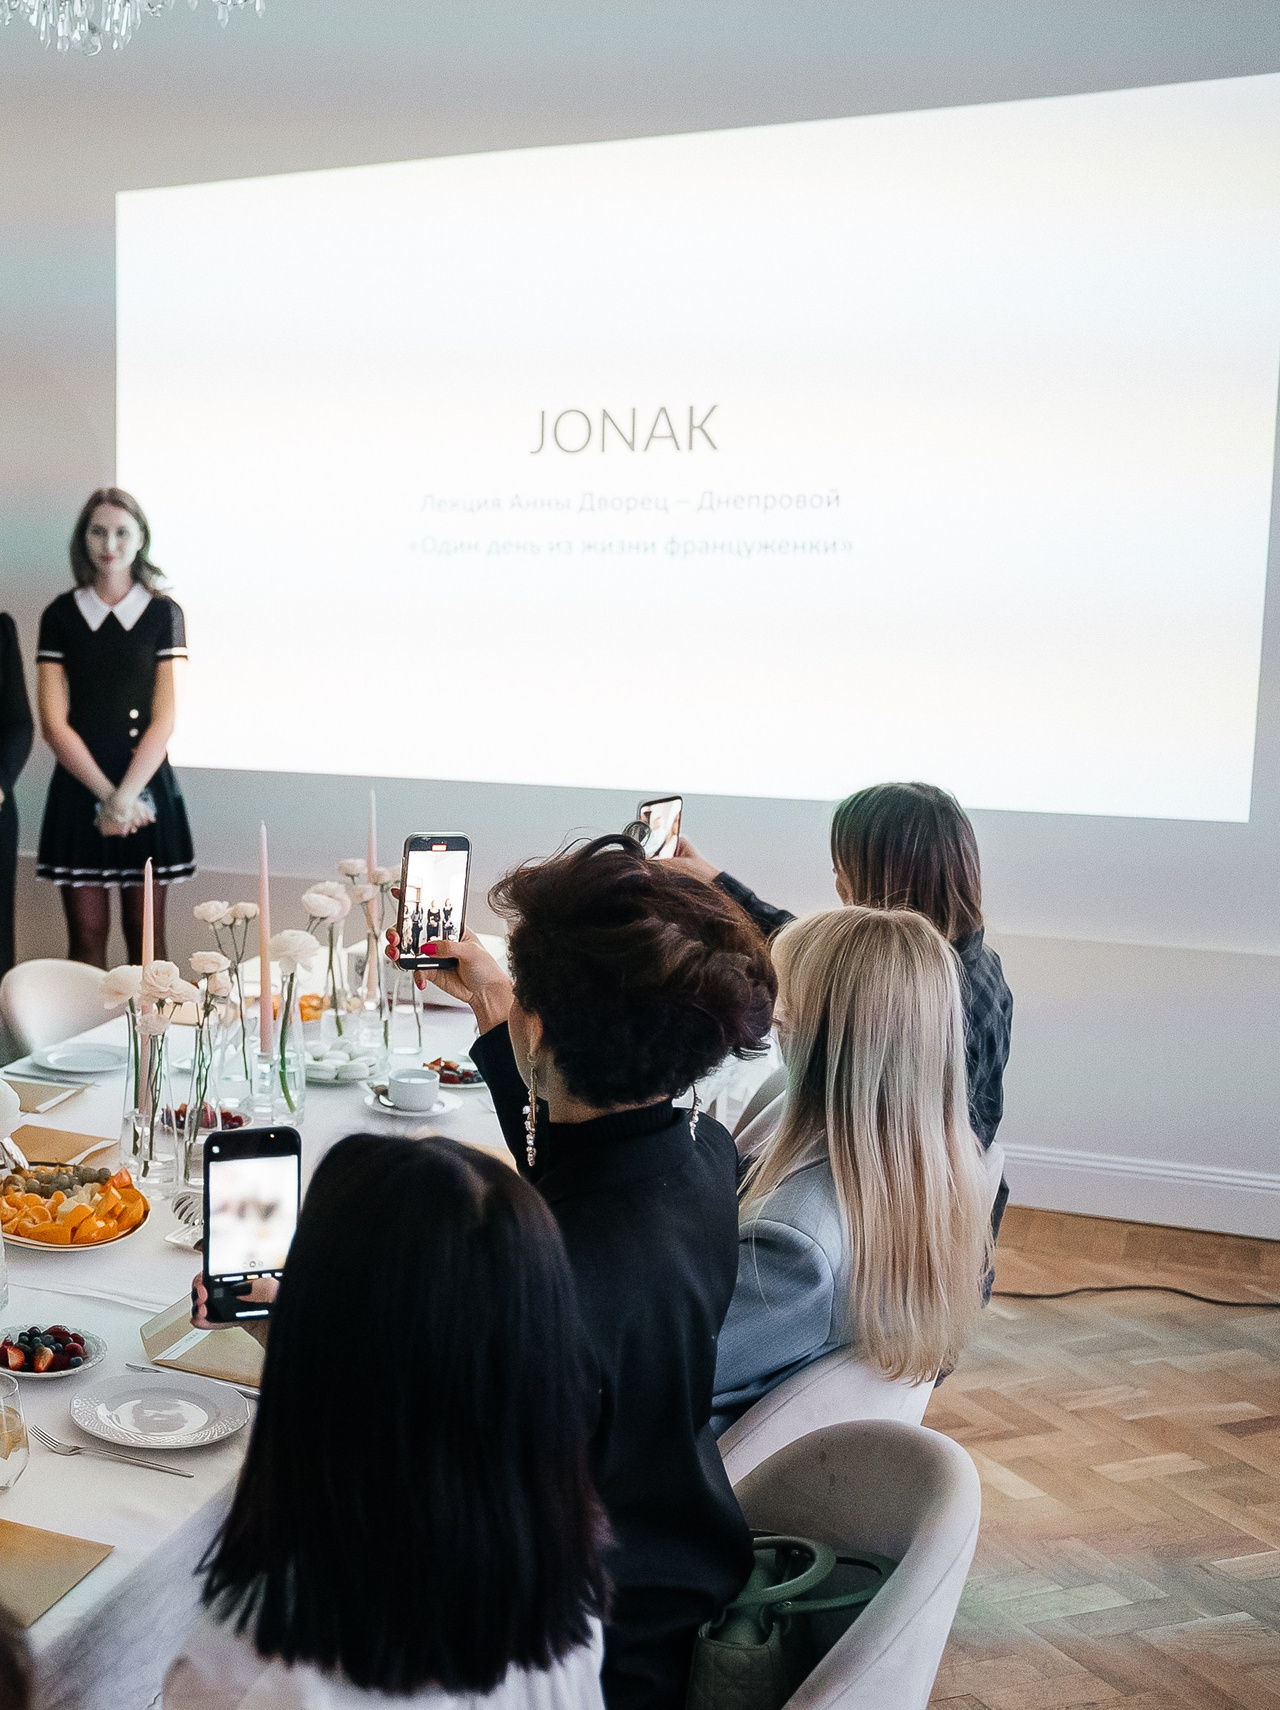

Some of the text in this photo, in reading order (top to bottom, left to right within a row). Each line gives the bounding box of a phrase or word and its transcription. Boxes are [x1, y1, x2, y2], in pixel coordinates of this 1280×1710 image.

[529, 403, 719, 456] JONAK
[419, 493, 503, 515] Лекция
[509, 494, 572, 514] Анны
[576, 491, 671, 516] Дворец
[695, 486, 842, 514] Днепровой
[407, 534, 855, 559] «Один день из жизни француженки»
